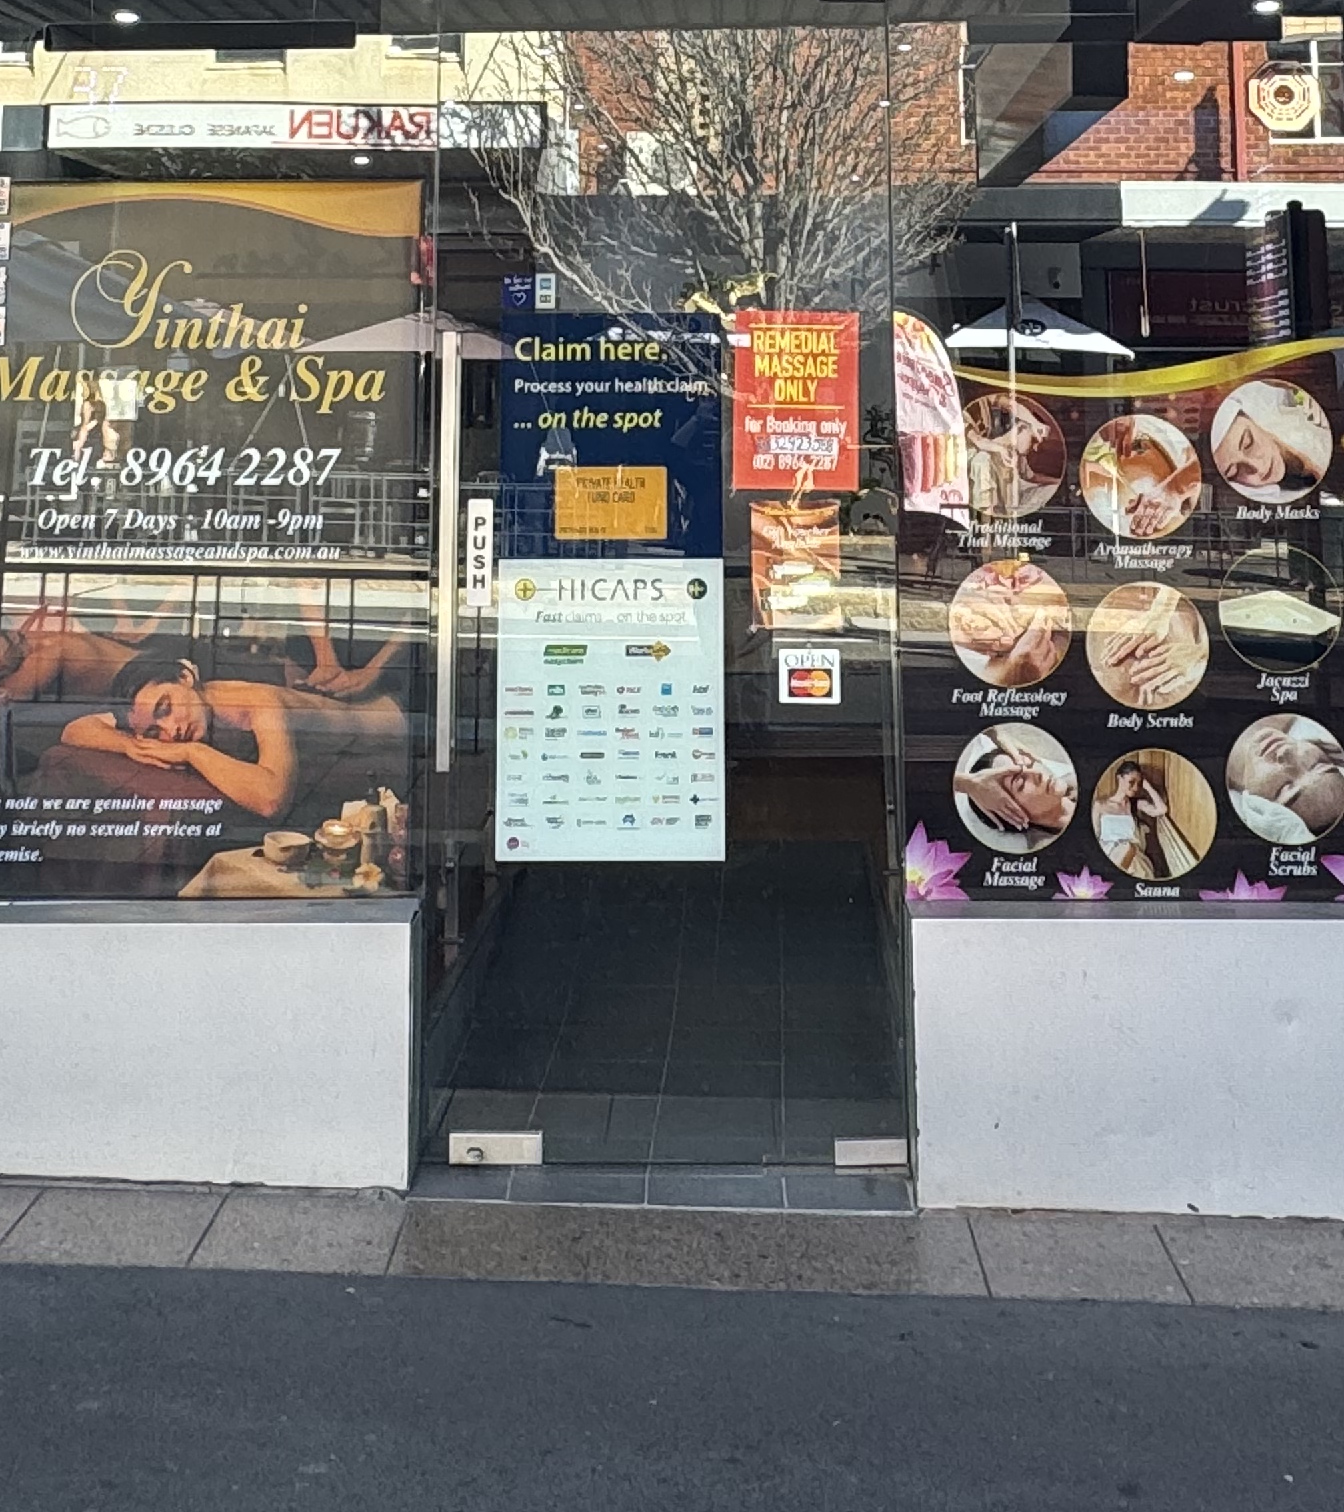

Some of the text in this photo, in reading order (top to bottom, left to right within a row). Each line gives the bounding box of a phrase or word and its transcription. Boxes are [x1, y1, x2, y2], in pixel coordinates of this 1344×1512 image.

[71, 249, 309, 349] Yinthai
[514, 337, 668, 361] Claim here.
[753, 330, 840, 354] REMEDIAL
[754, 355, 839, 378] MASSAGE
[224, 355, 271, 402] &
[289, 354, 386, 414] Spa
[514, 378, 572, 393] Process
[575, 381, 611, 397] your
[615, 377, 663, 394] health
[774, 378, 818, 402] ONLY
[537, 411, 567, 430] on
[572, 406, 608, 430] the
[612, 408, 664, 434] spot
[744, 416, 848, 439] for Booking only
[120, 447, 226, 487] 8964
[234, 448, 342, 487] 2287
[38, 509, 96, 535] Open
[104, 509, 119, 530] 7
[122, 509, 178, 534] Days
[201, 509, 261, 530] 10am
[267, 509, 324, 536] -9pm
[1235, 505, 1322, 524] Body Masks
[992, 534, 1052, 551] Massage
[472, 516, 487, 590] PUSH
[1114, 555, 1175, 571] Massage
[558, 578, 664, 601] HICAPS
[535, 611, 563, 624] Fast
[785, 654, 835, 668] OPEN
[951, 688, 1067, 707] Foot Reflexology
[1270, 687, 1299, 705] Spa
[979, 702, 1040, 719] Massage
[1107, 713, 1194, 733] Body Scrubs
[5, 794, 38, 810] note
[43, 797, 61, 811] we
[65, 797, 90, 810] are
[93, 794, 155, 815] genuine
[158, 797, 223, 815] massage
[66, 824, 87, 837] no
[89, 819, 139, 837] sexual
[142, 821, 202, 837] services
[205, 821, 222, 837] at
[1270, 845, 1316, 863] Facial
[991, 856, 1038, 874] Facial
[1268, 861, 1319, 877] Scrubs
[983, 871, 1047, 890] Massage
[1134, 882, 1181, 899] Sauna
